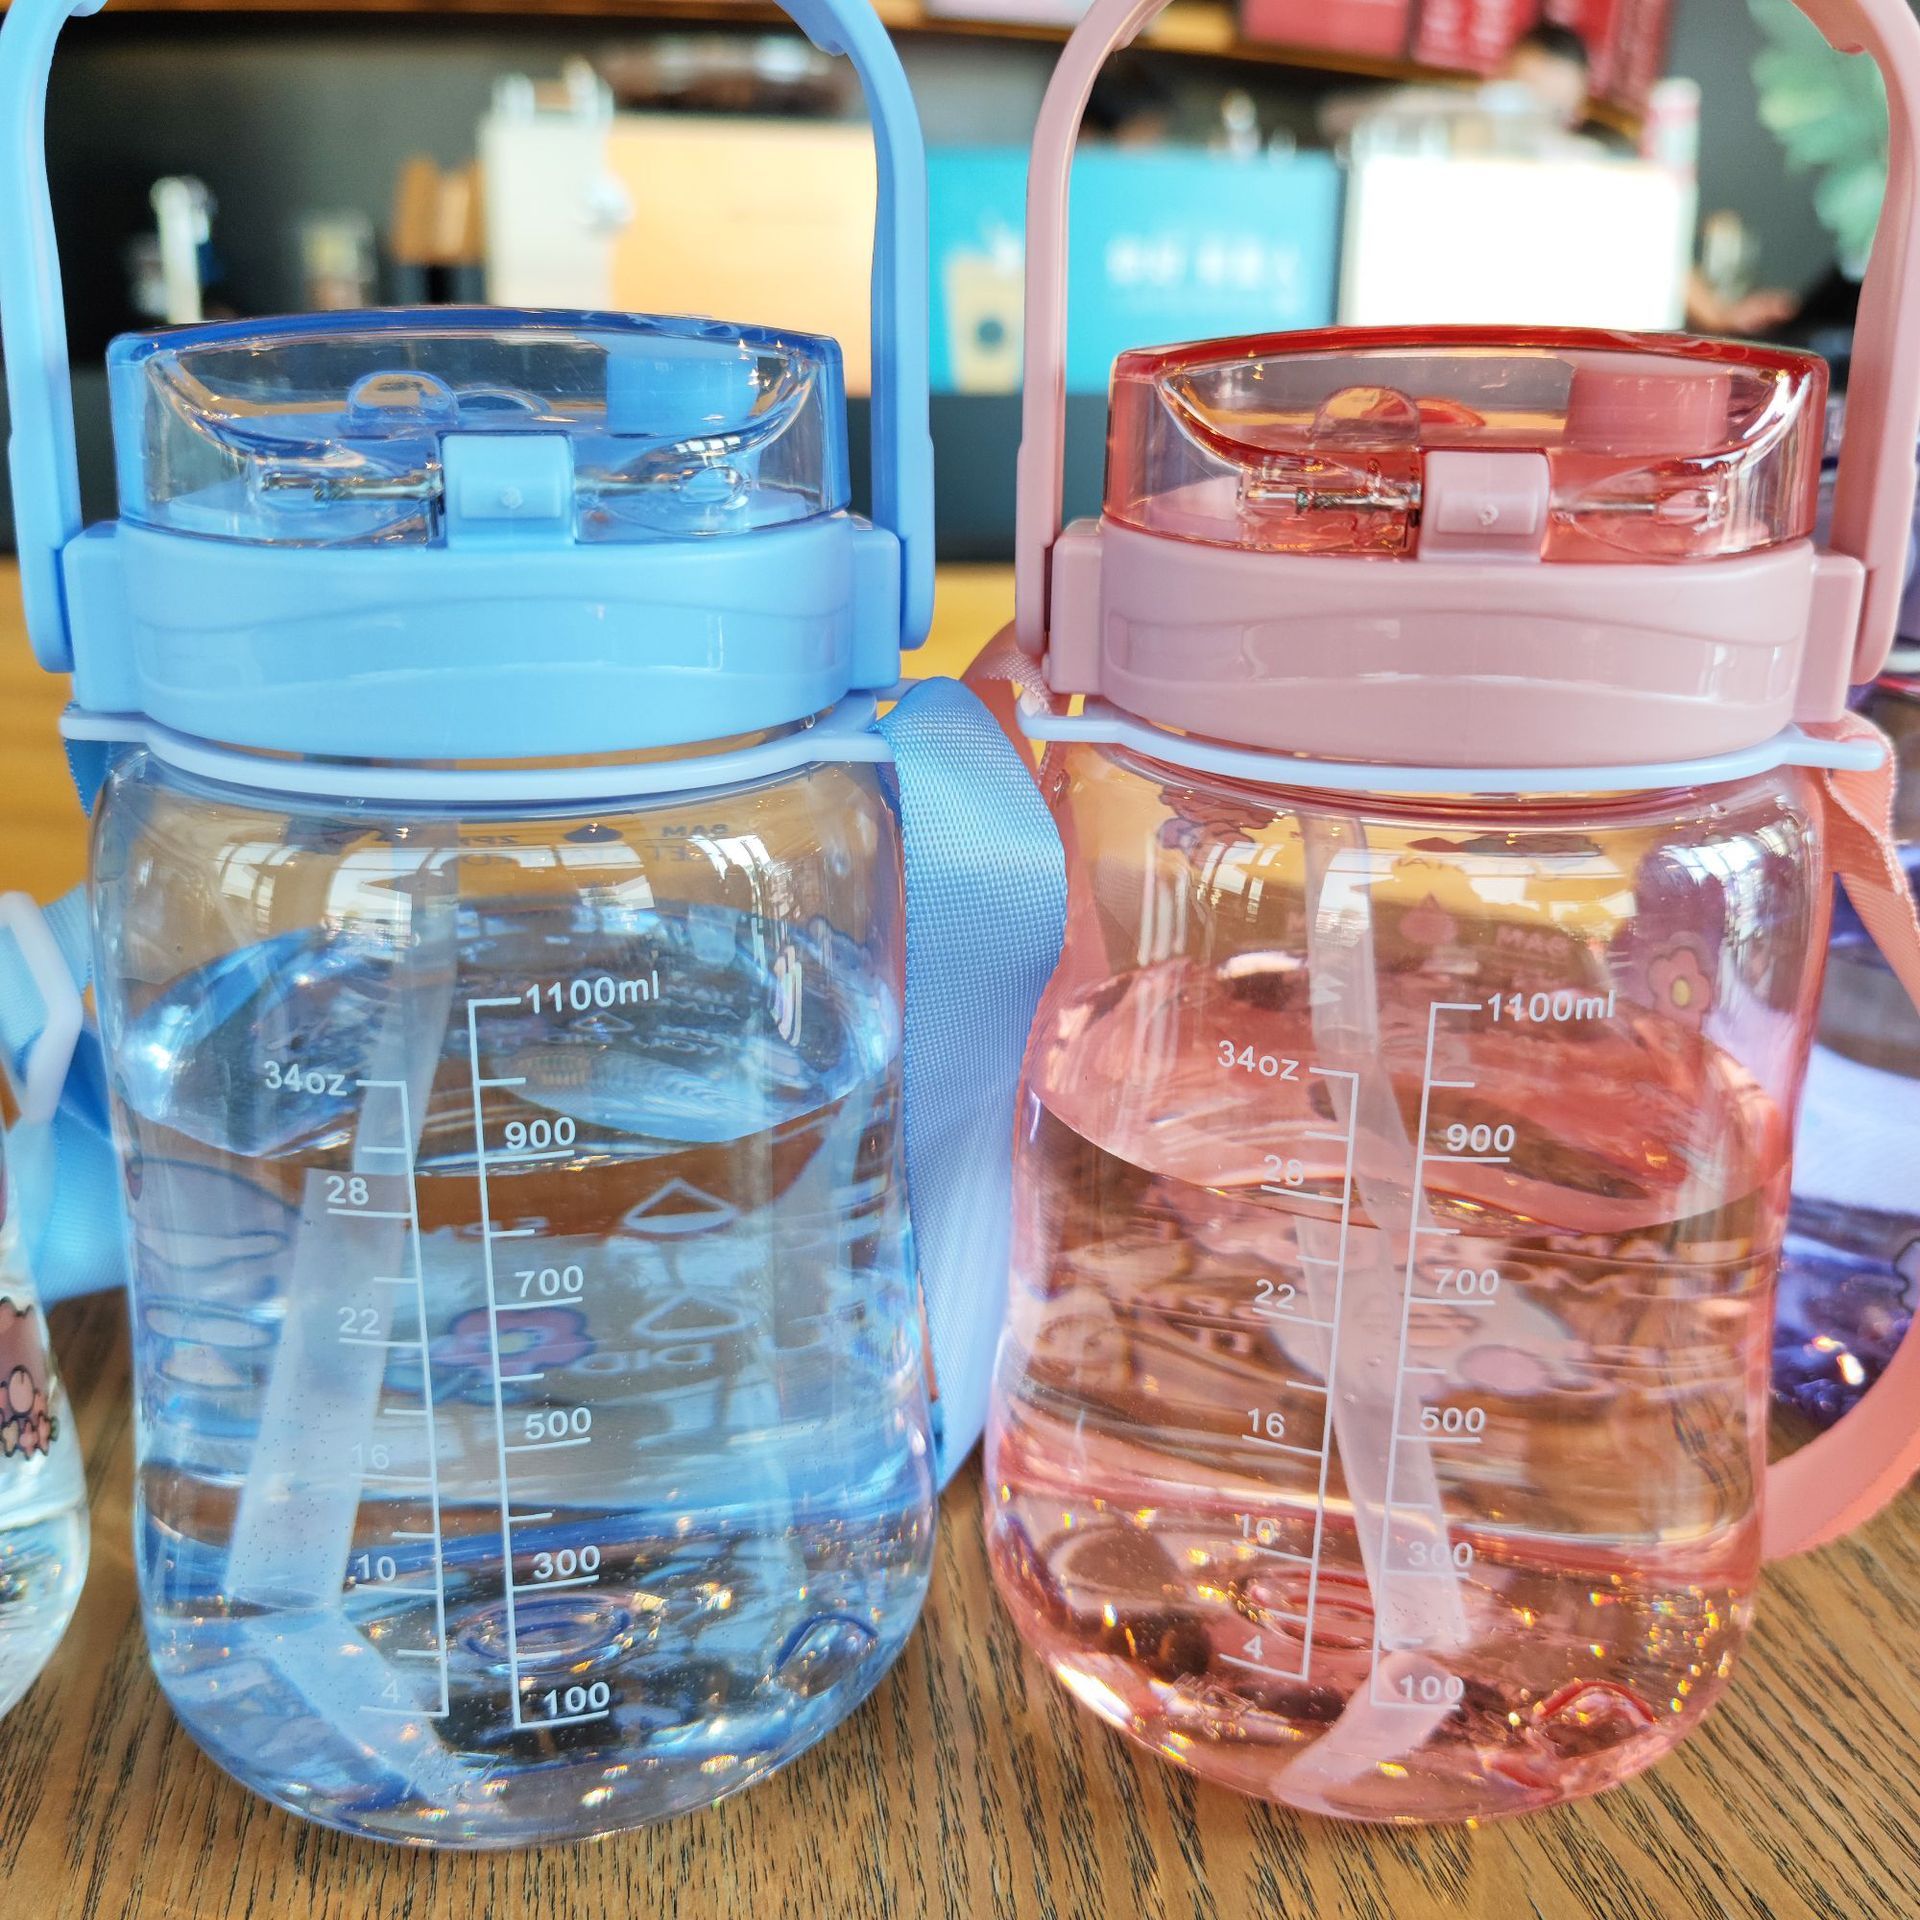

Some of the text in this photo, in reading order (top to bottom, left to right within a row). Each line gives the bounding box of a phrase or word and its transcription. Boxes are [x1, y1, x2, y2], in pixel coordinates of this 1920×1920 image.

[526, 970, 660, 1014] 1100ml
[1488, 990, 1616, 1023] 1100ml
[1217, 1040, 1300, 1081] 34oz
[264, 1060, 348, 1097] 34oz
[504, 1116, 577, 1151] 900
[1446, 1124, 1516, 1152] 900
[1263, 1154, 1304, 1186] 28
[325, 1175, 370, 1205] 28
[515, 1265, 584, 1298] 700
[1254, 1278, 1297, 1310] 22
[1434, 1268, 1500, 1296] 700
[337, 1306, 381, 1335] 22
[524, 1406, 592, 1440] 500
[1247, 1407, 1286, 1438] 16
[1419, 1406, 1486, 1433] 500
[351, 1443, 390, 1470] 16
[354, 1554, 397, 1582] 10
[533, 1545, 600, 1580] 300
[1408, 1541, 1474, 1568] 300
[1243, 1635, 1264, 1660] 4
[381, 1679, 401, 1703] 4
[543, 1682, 610, 1716] 100
[1400, 1674, 1465, 1701] 100
